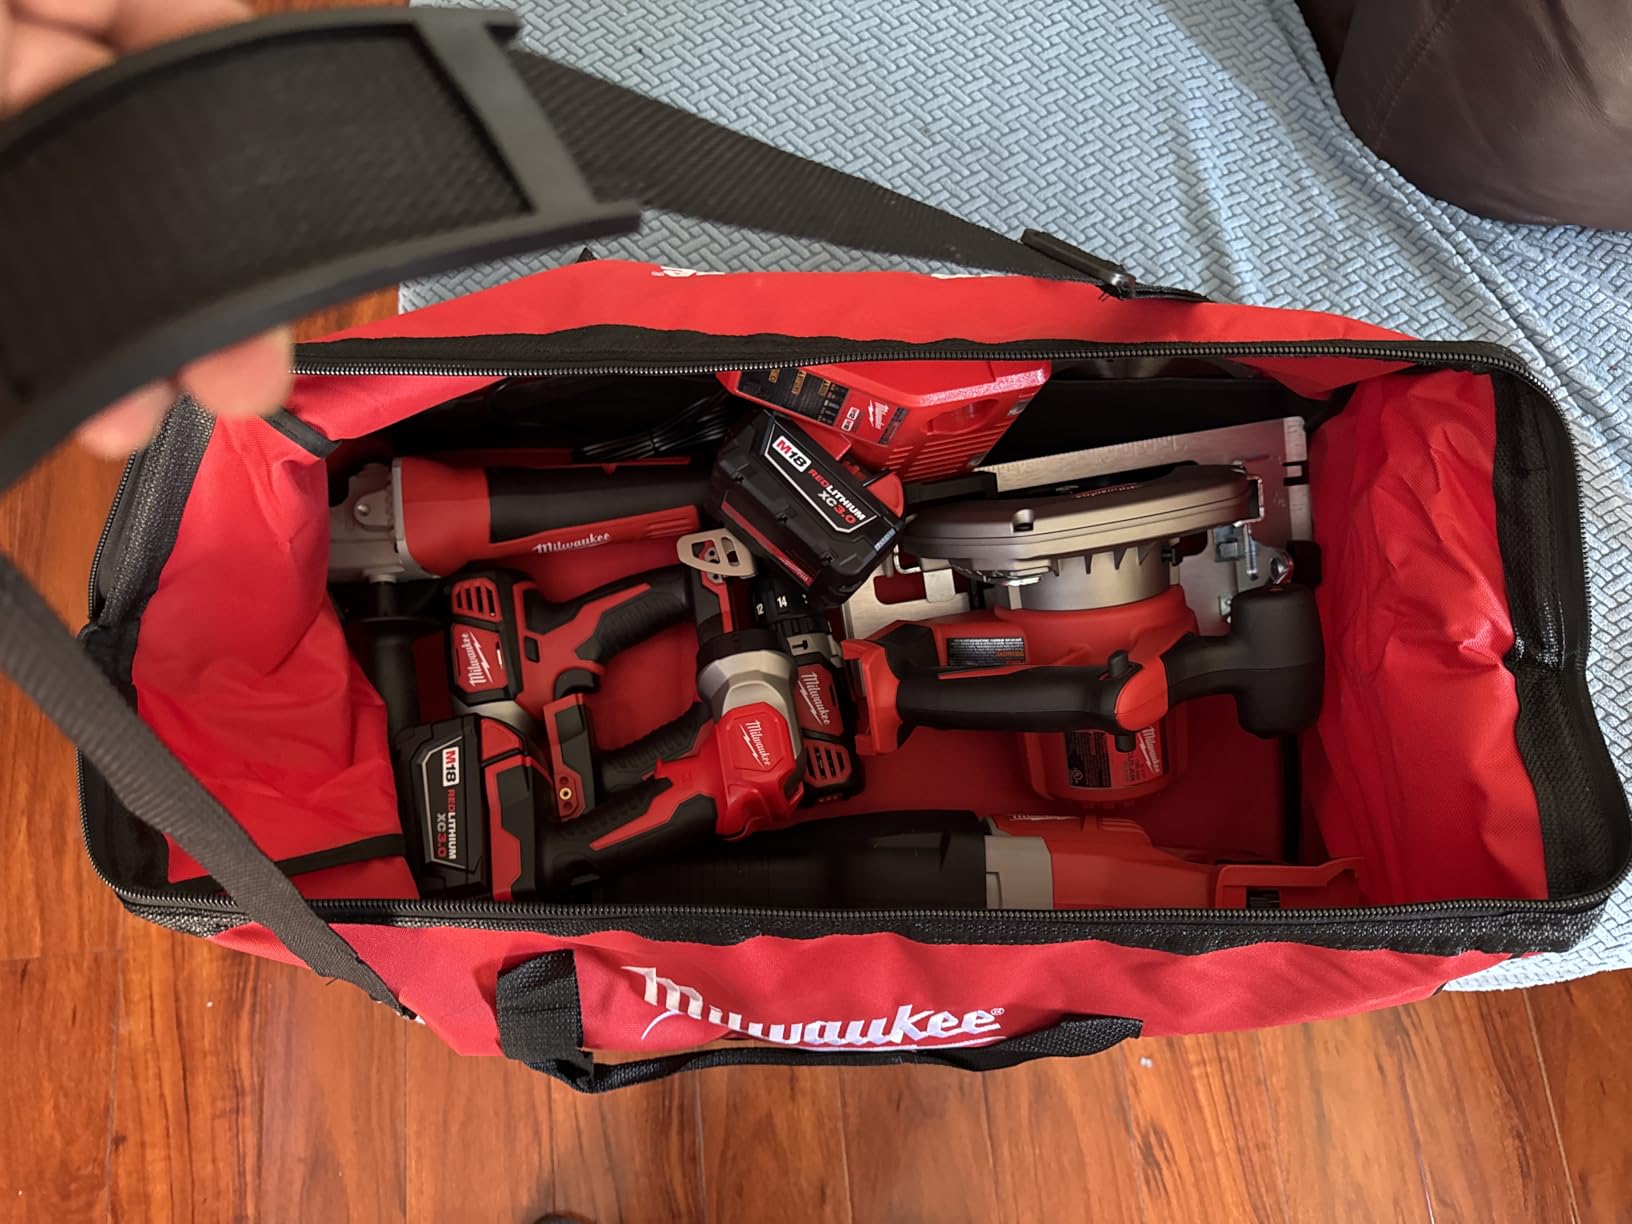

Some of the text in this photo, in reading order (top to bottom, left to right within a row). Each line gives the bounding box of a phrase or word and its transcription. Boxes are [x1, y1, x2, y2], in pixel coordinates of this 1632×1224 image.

[776, 439, 866, 521] M18 REDLITHIUM
[817, 490, 857, 524] XC3.0
[532, 533, 611, 554] Milwaukee
[776, 595, 788, 608] 14
[461, 633, 487, 687] Milwaukee
[801, 672, 831, 725] Milwaukee
[745, 719, 771, 766] Milwaukee
[445, 750, 457, 860] M18 REDLITHIUM
[437, 812, 447, 858] XC3.0
